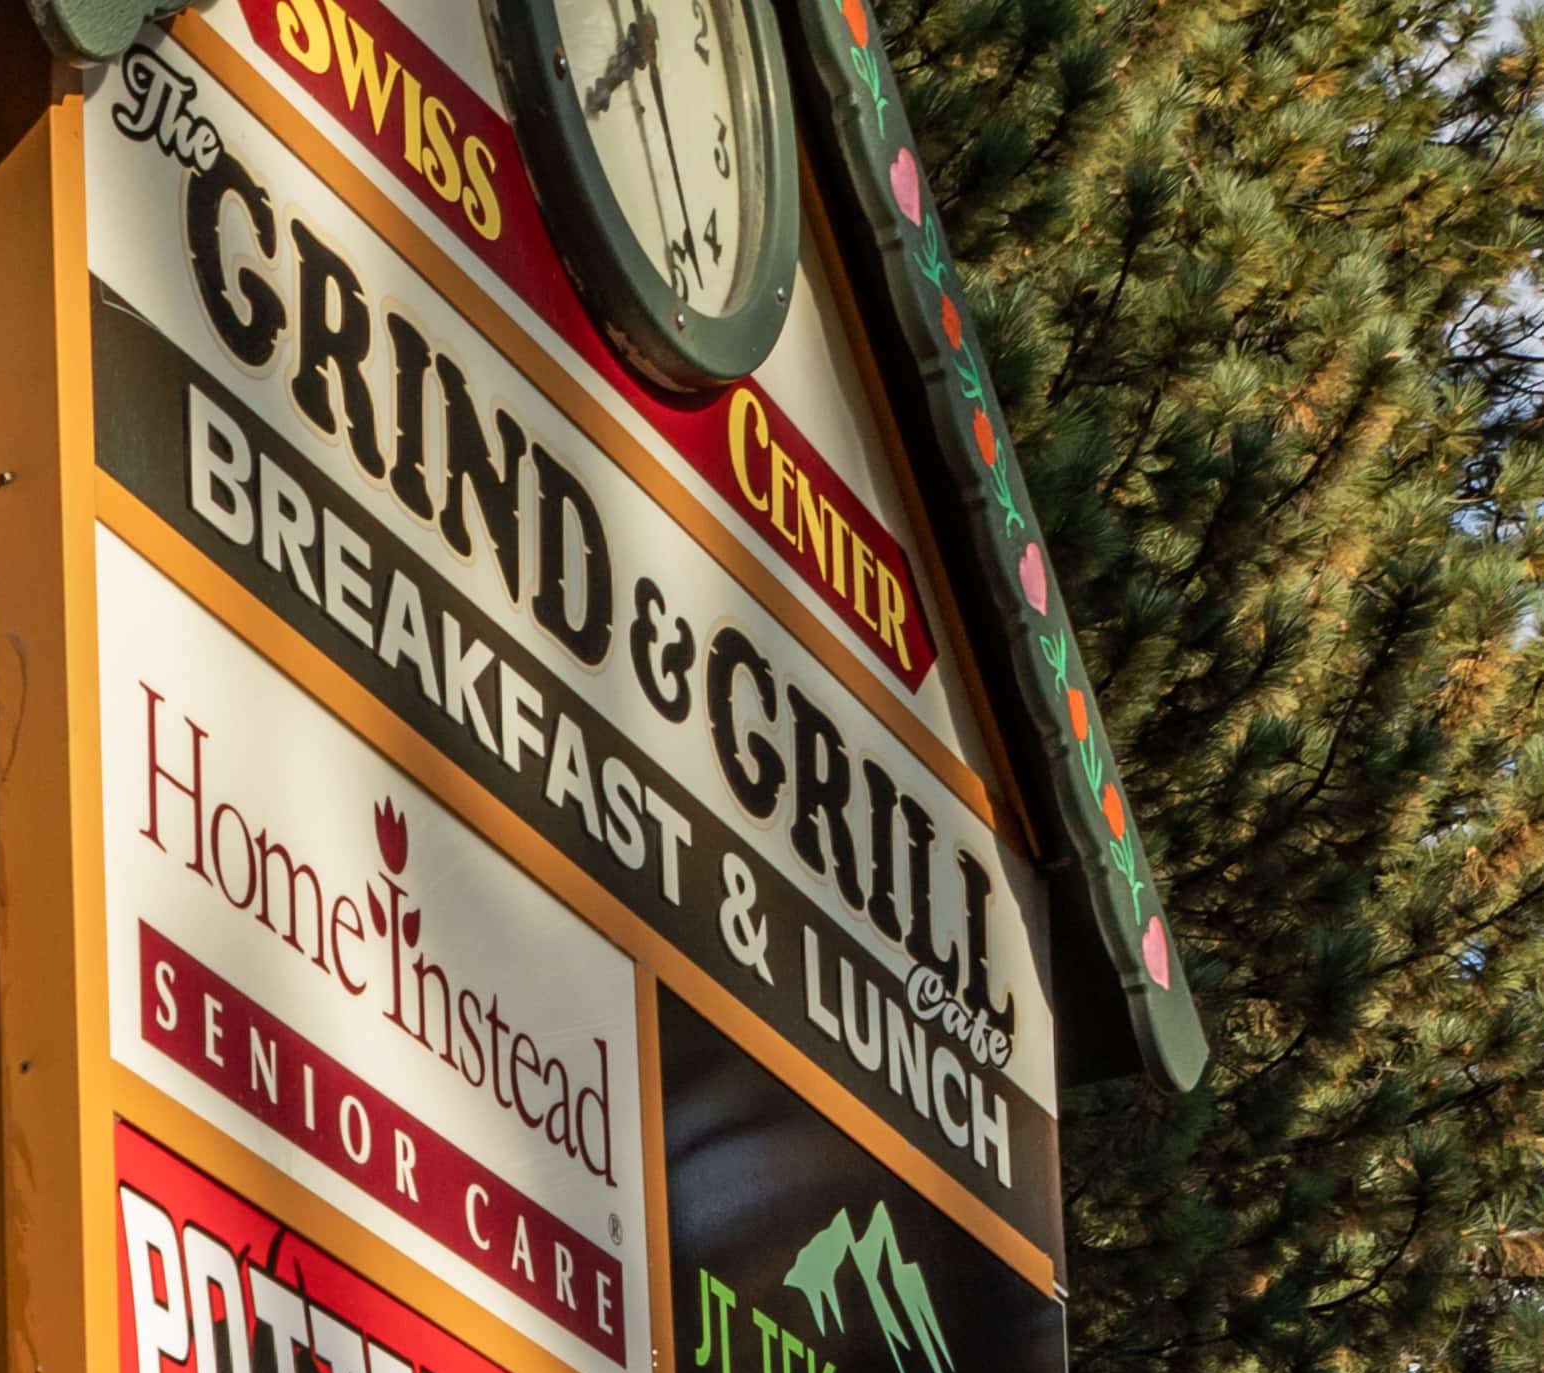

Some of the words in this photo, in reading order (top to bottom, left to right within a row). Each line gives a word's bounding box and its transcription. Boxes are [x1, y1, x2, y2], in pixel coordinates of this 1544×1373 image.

[112, 43, 225, 172] The
[277, 0, 502, 241] SWISS
[186, 150, 612, 667] GRIND
[631, 577, 696, 724] &
[706, 627, 1018, 1038] GRILL
[728, 387, 912, 671] CENTER
[188, 384, 693, 906] BREAKFAST
[719, 849, 773, 984] &
[803, 925, 1013, 1188] LUNCH
[154, 961, 420, 1202] SENIOR
[465, 1182, 614, 1336] CARE
[906, 965, 1013, 1068] Cafe
